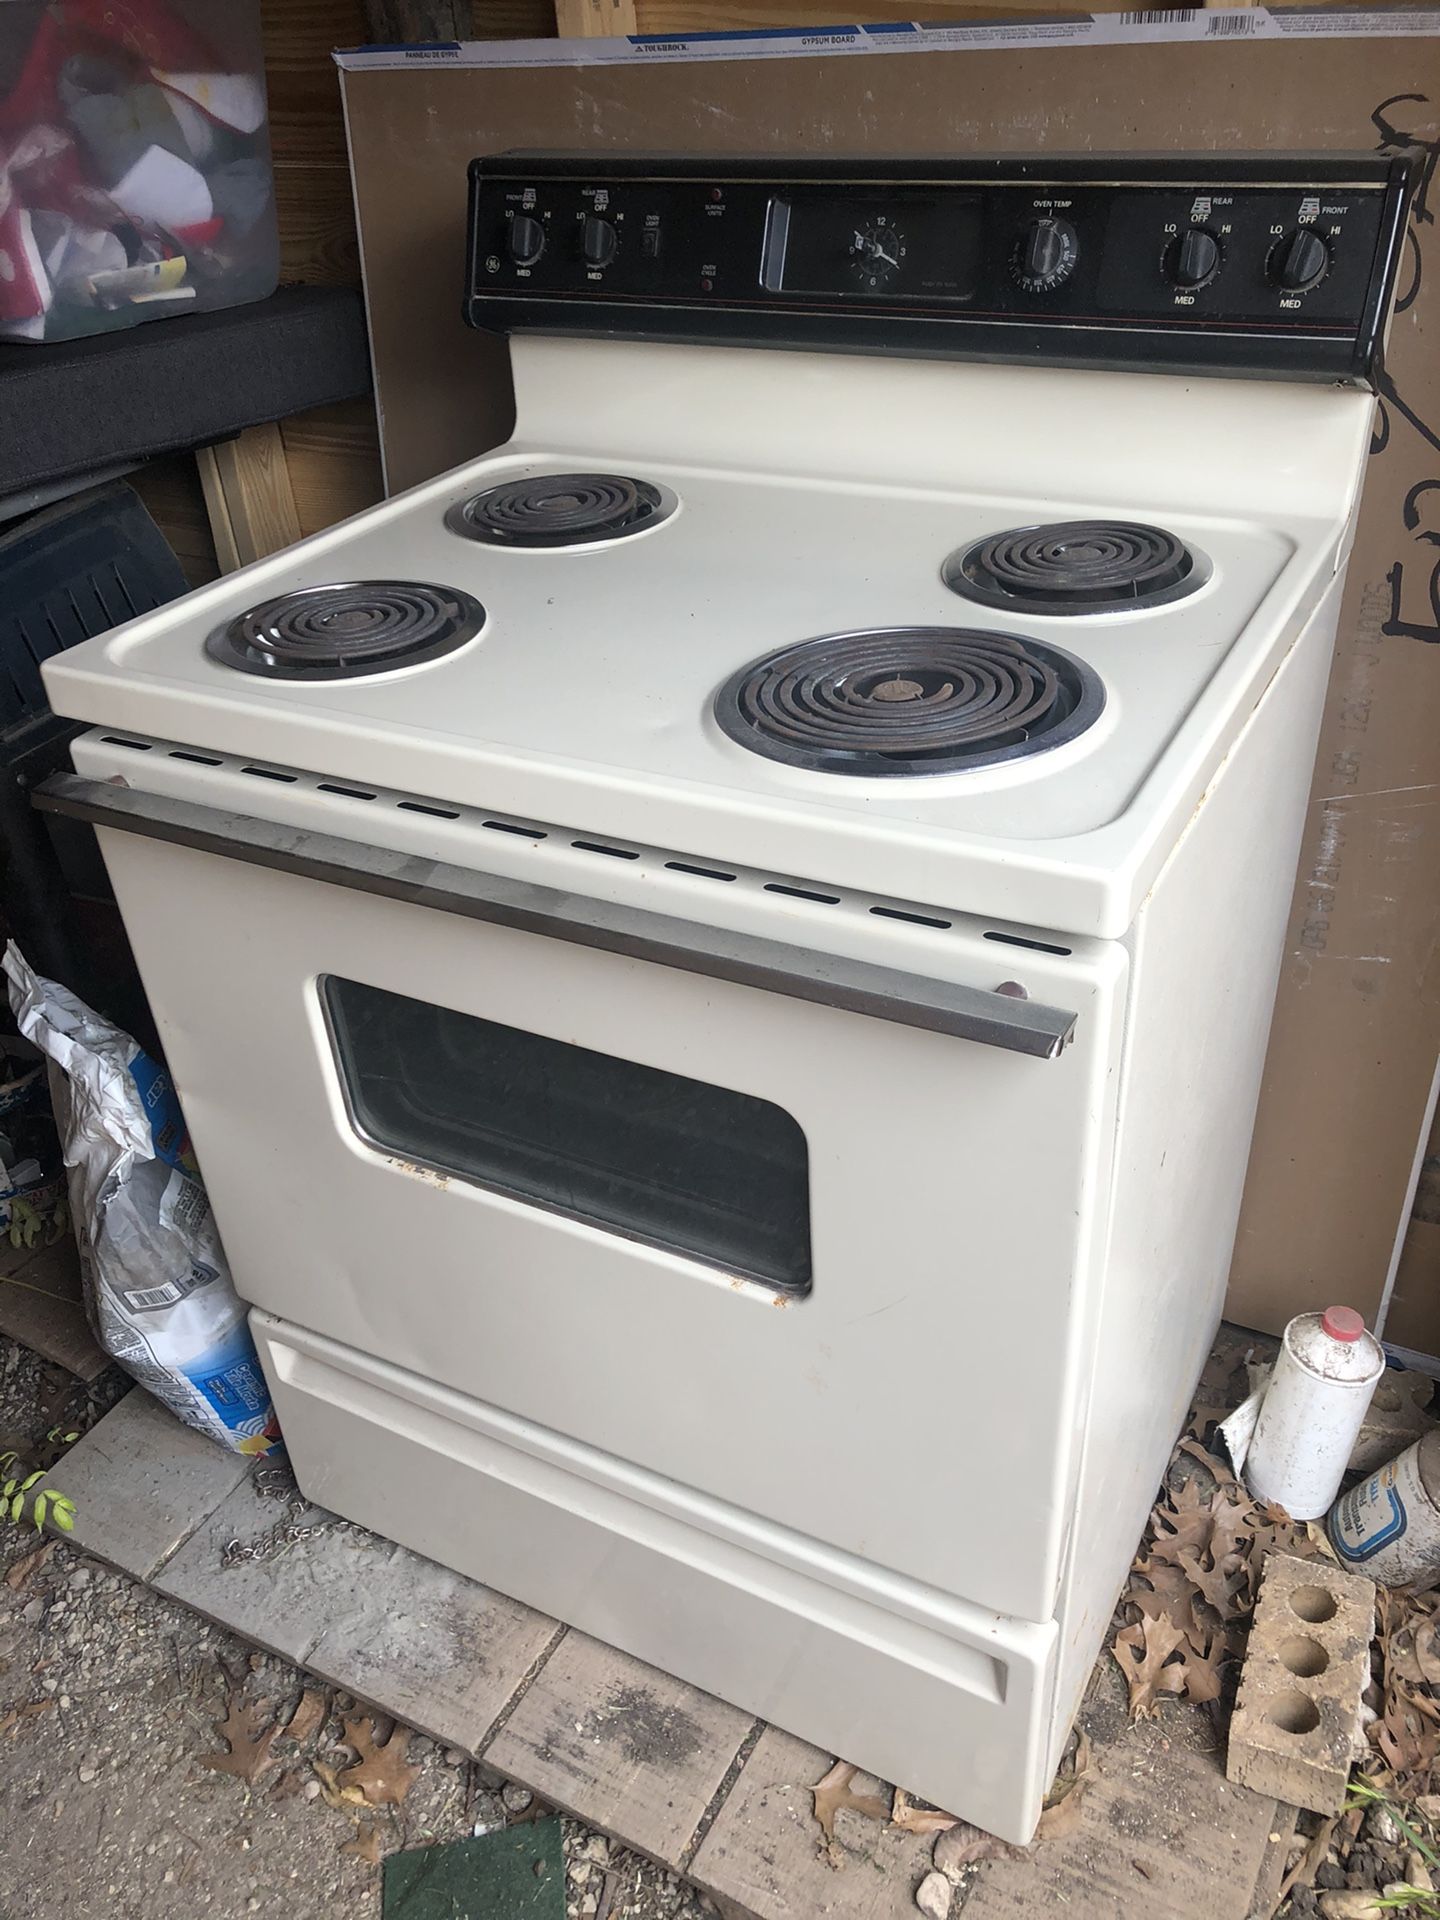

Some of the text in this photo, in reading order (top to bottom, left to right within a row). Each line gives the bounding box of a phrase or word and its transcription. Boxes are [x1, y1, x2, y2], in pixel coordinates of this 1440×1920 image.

[801, 35, 856, 45] GYPSUM BOARD
[522, 202, 536, 210] OFF
[1033, 200, 1073, 208] OVEN TEMP
[1212, 197, 1233, 206] REAR
[594, 203, 608, 212] OFF
[1321, 206, 1349, 215] FRONT
[616, 212, 625, 221] HI
[876, 216, 887, 226] 12
[1190, 213, 1209, 224] OFF
[1297, 214, 1317, 225] OFF
[1164, 223, 1177, 234] LO
[1220, 224, 1232, 235] HI
[1269, 225, 1284, 236] LO
[1330, 226, 1342, 237] HI
[899, 246, 907, 257] 3
[516, 269, 532, 278] MED
[587, 272, 603, 281] MED
[869, 276, 877, 287] 6
[1174, 296, 1195, 305] MED
[1280, 299, 1301, 309] MED
